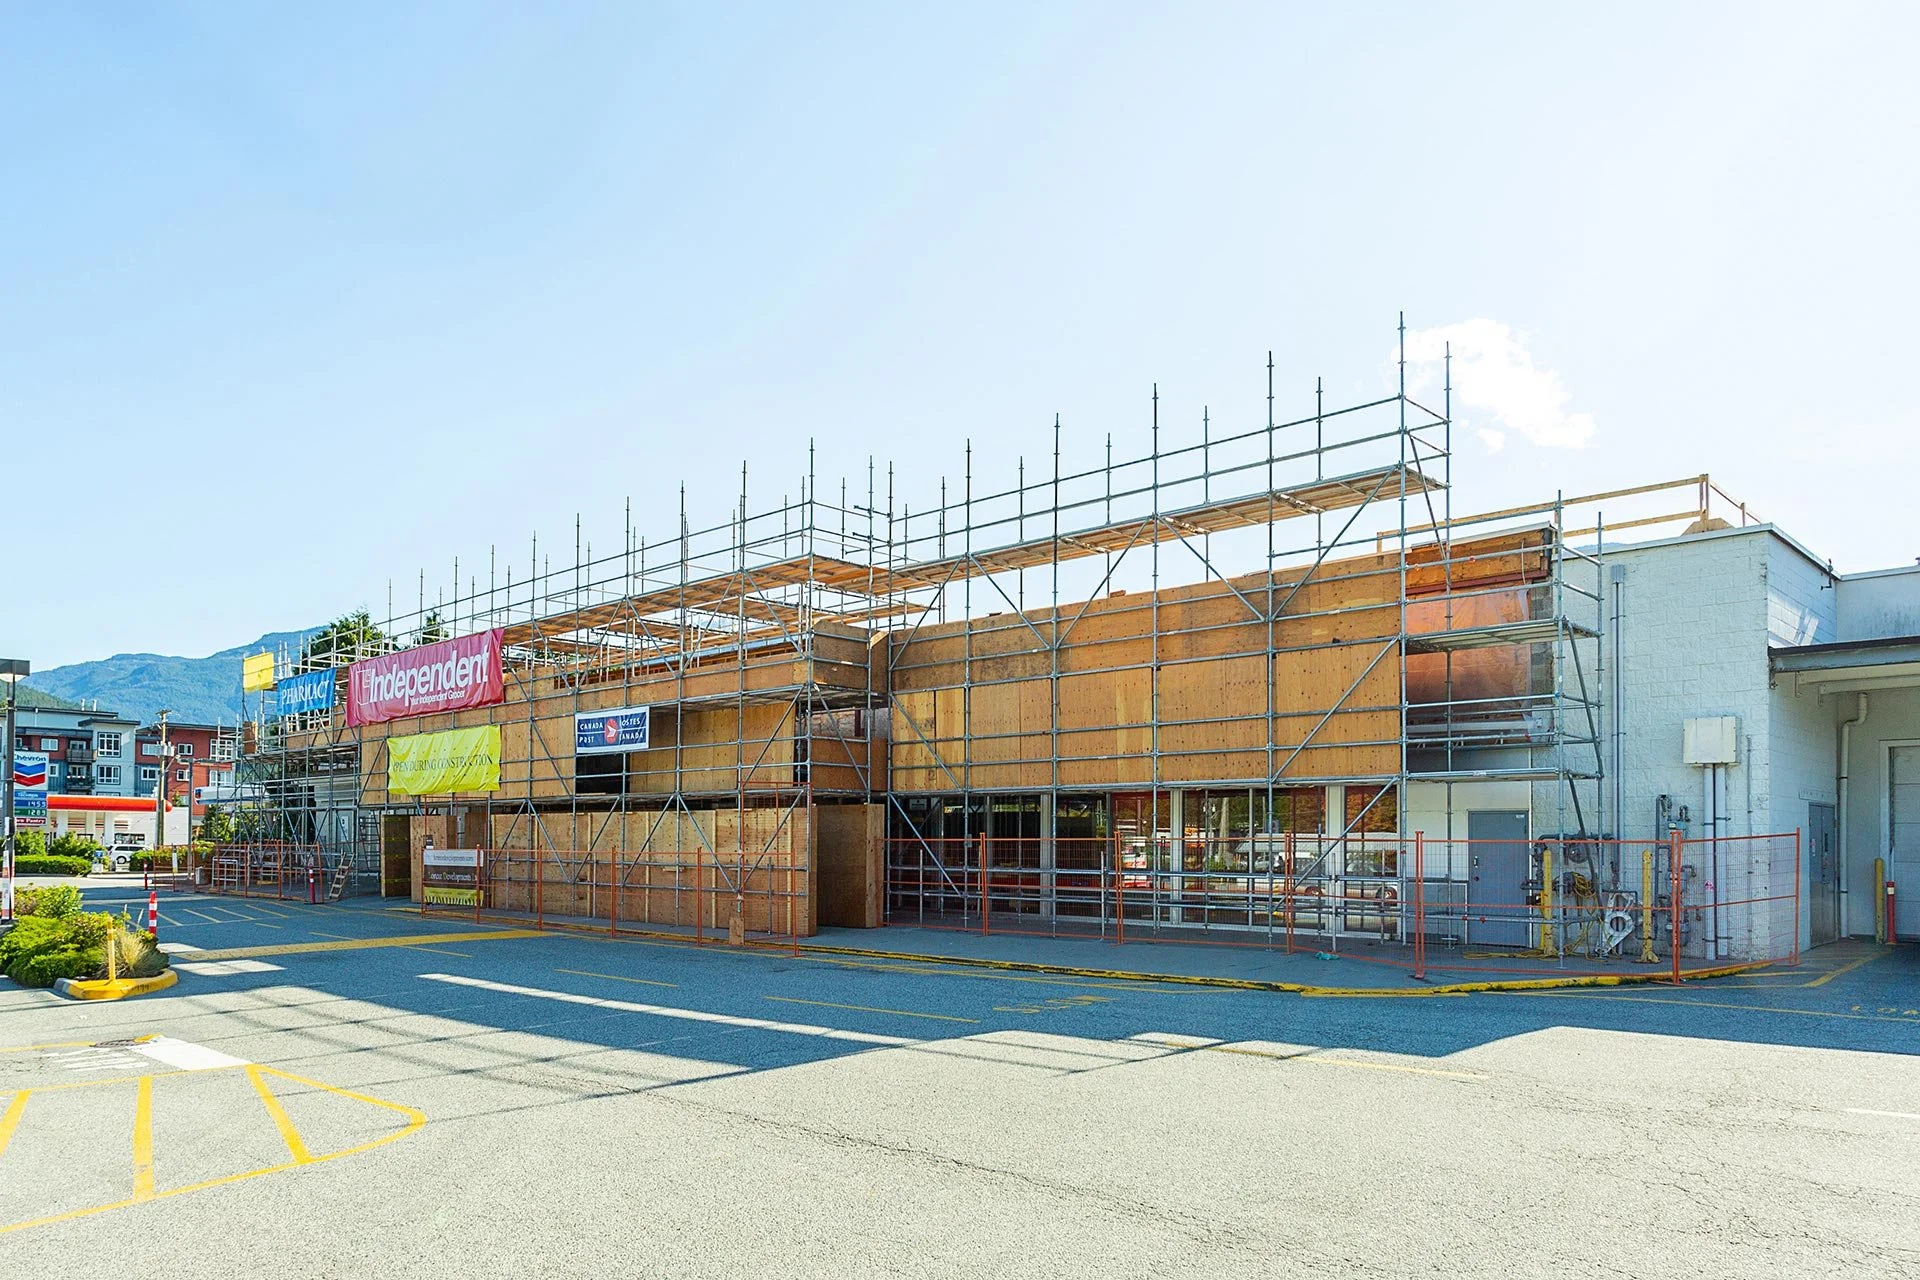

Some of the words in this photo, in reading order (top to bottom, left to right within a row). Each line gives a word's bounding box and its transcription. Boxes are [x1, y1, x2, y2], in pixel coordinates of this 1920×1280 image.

[369, 644, 489, 707] Independent
[420, 691, 448, 705] Independent
[579, 722, 604, 730] CANADA
[620, 717, 641, 727] OSTES
[578, 736, 595, 744] POST
